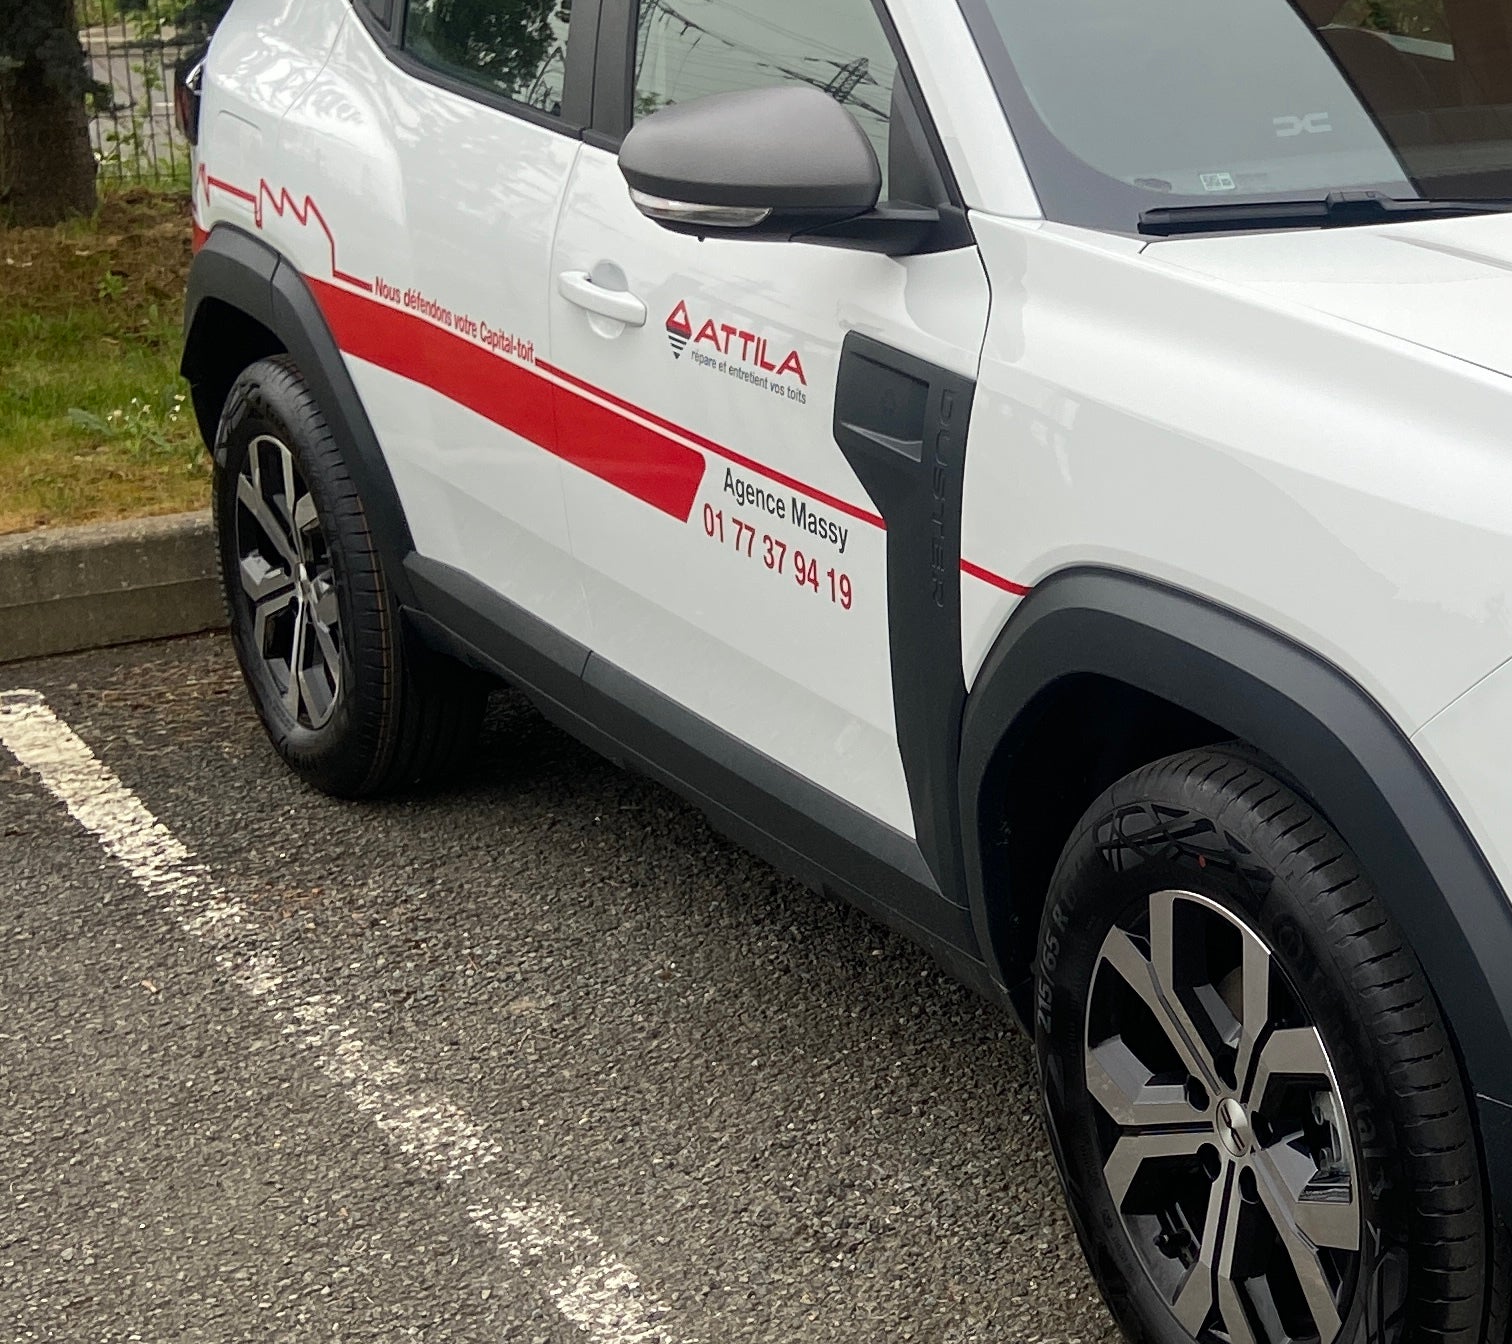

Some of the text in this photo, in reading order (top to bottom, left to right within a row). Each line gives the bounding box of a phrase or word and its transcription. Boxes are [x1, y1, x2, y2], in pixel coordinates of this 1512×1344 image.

[375, 276, 534, 363] Nous défendons votre Capital-toit
[693, 318, 808, 387] ATTILA
[691, 349, 807, 405] répare et entretient vos toits
[723, 467, 848, 554] Agence Massy
[703, 503, 852, 611] 01 77 37 94 19
